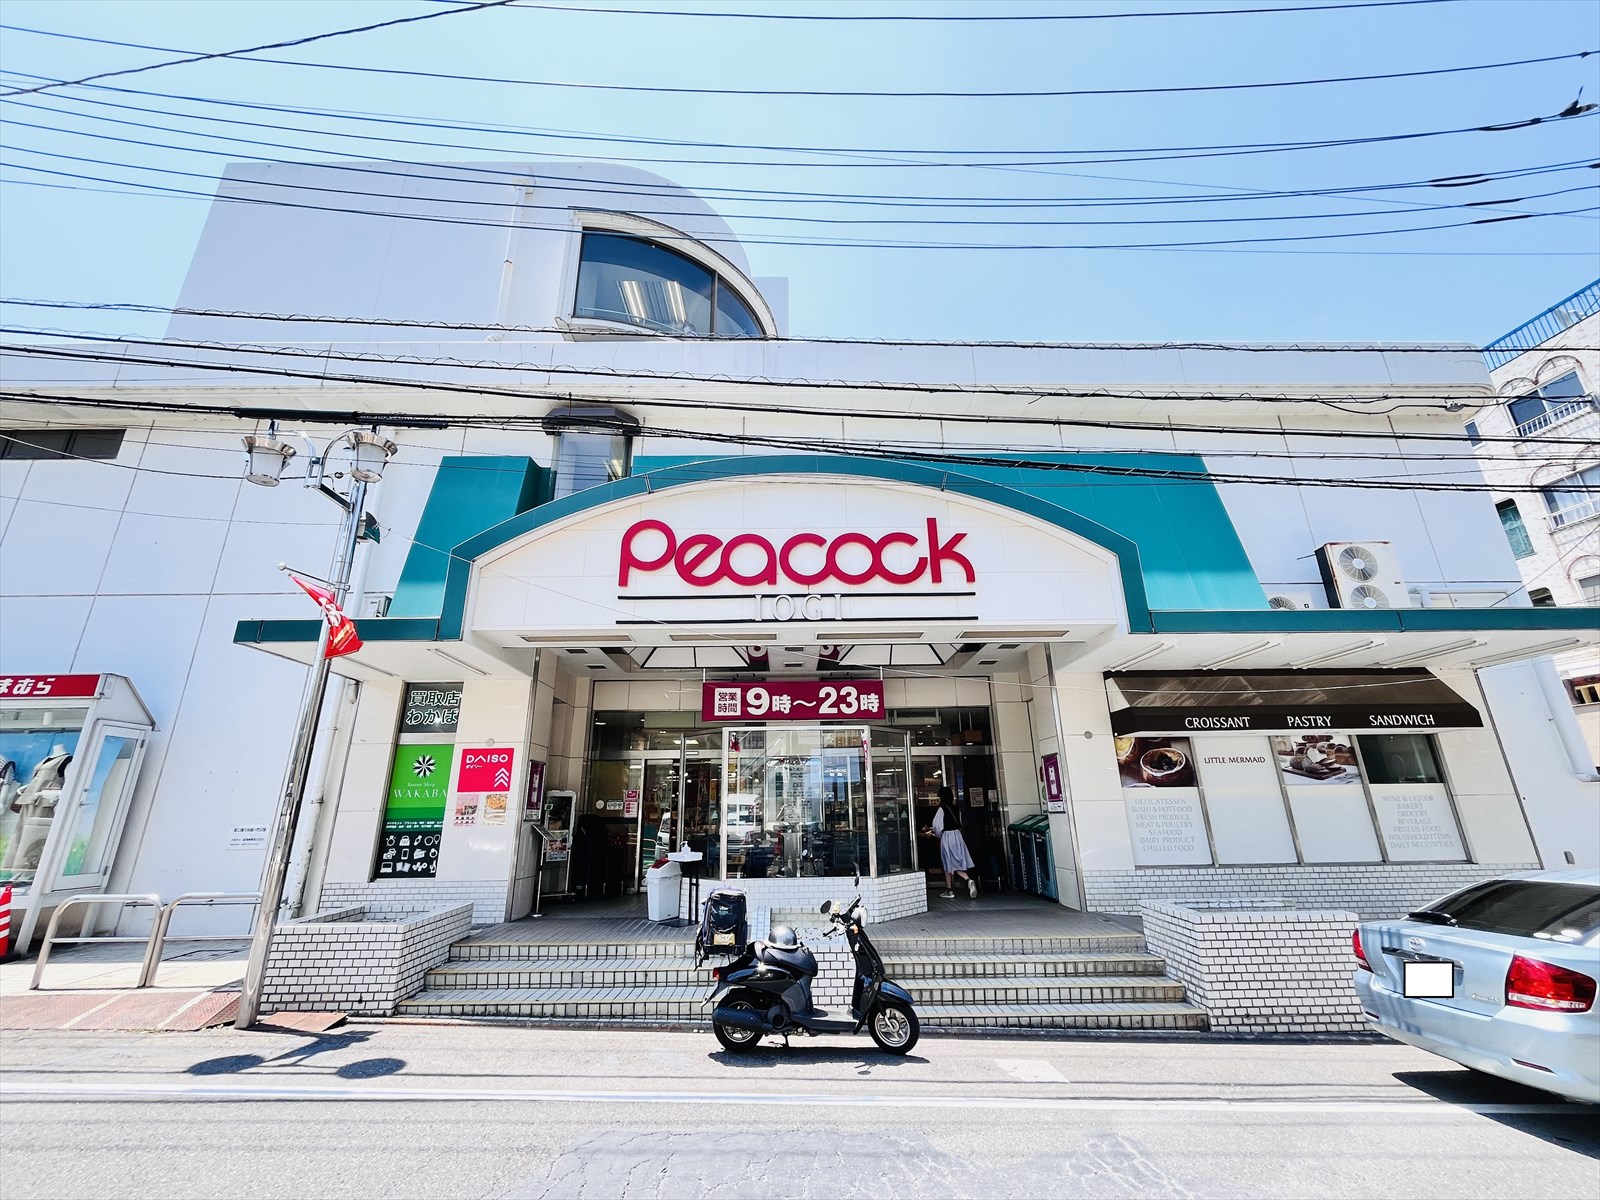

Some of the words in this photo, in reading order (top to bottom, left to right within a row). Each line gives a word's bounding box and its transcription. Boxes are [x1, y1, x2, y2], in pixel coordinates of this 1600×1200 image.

[618, 517, 976, 587] Peacock
[755, 593, 842, 621] IOGI
[409, 690, 463, 706] 買取店
[718, 692, 738, 702] 営業
[717, 703, 738, 713] 時間
[406, 708, 459, 725] わかば
[1185, 716, 1250, 728] CROISSANT
[1287, 715, 1332, 727] PASTRY
[1369, 714, 1435, 726] SANDWICH
[466, 754, 509, 763] DAISO
[394, 789, 447, 798] WAKABA
